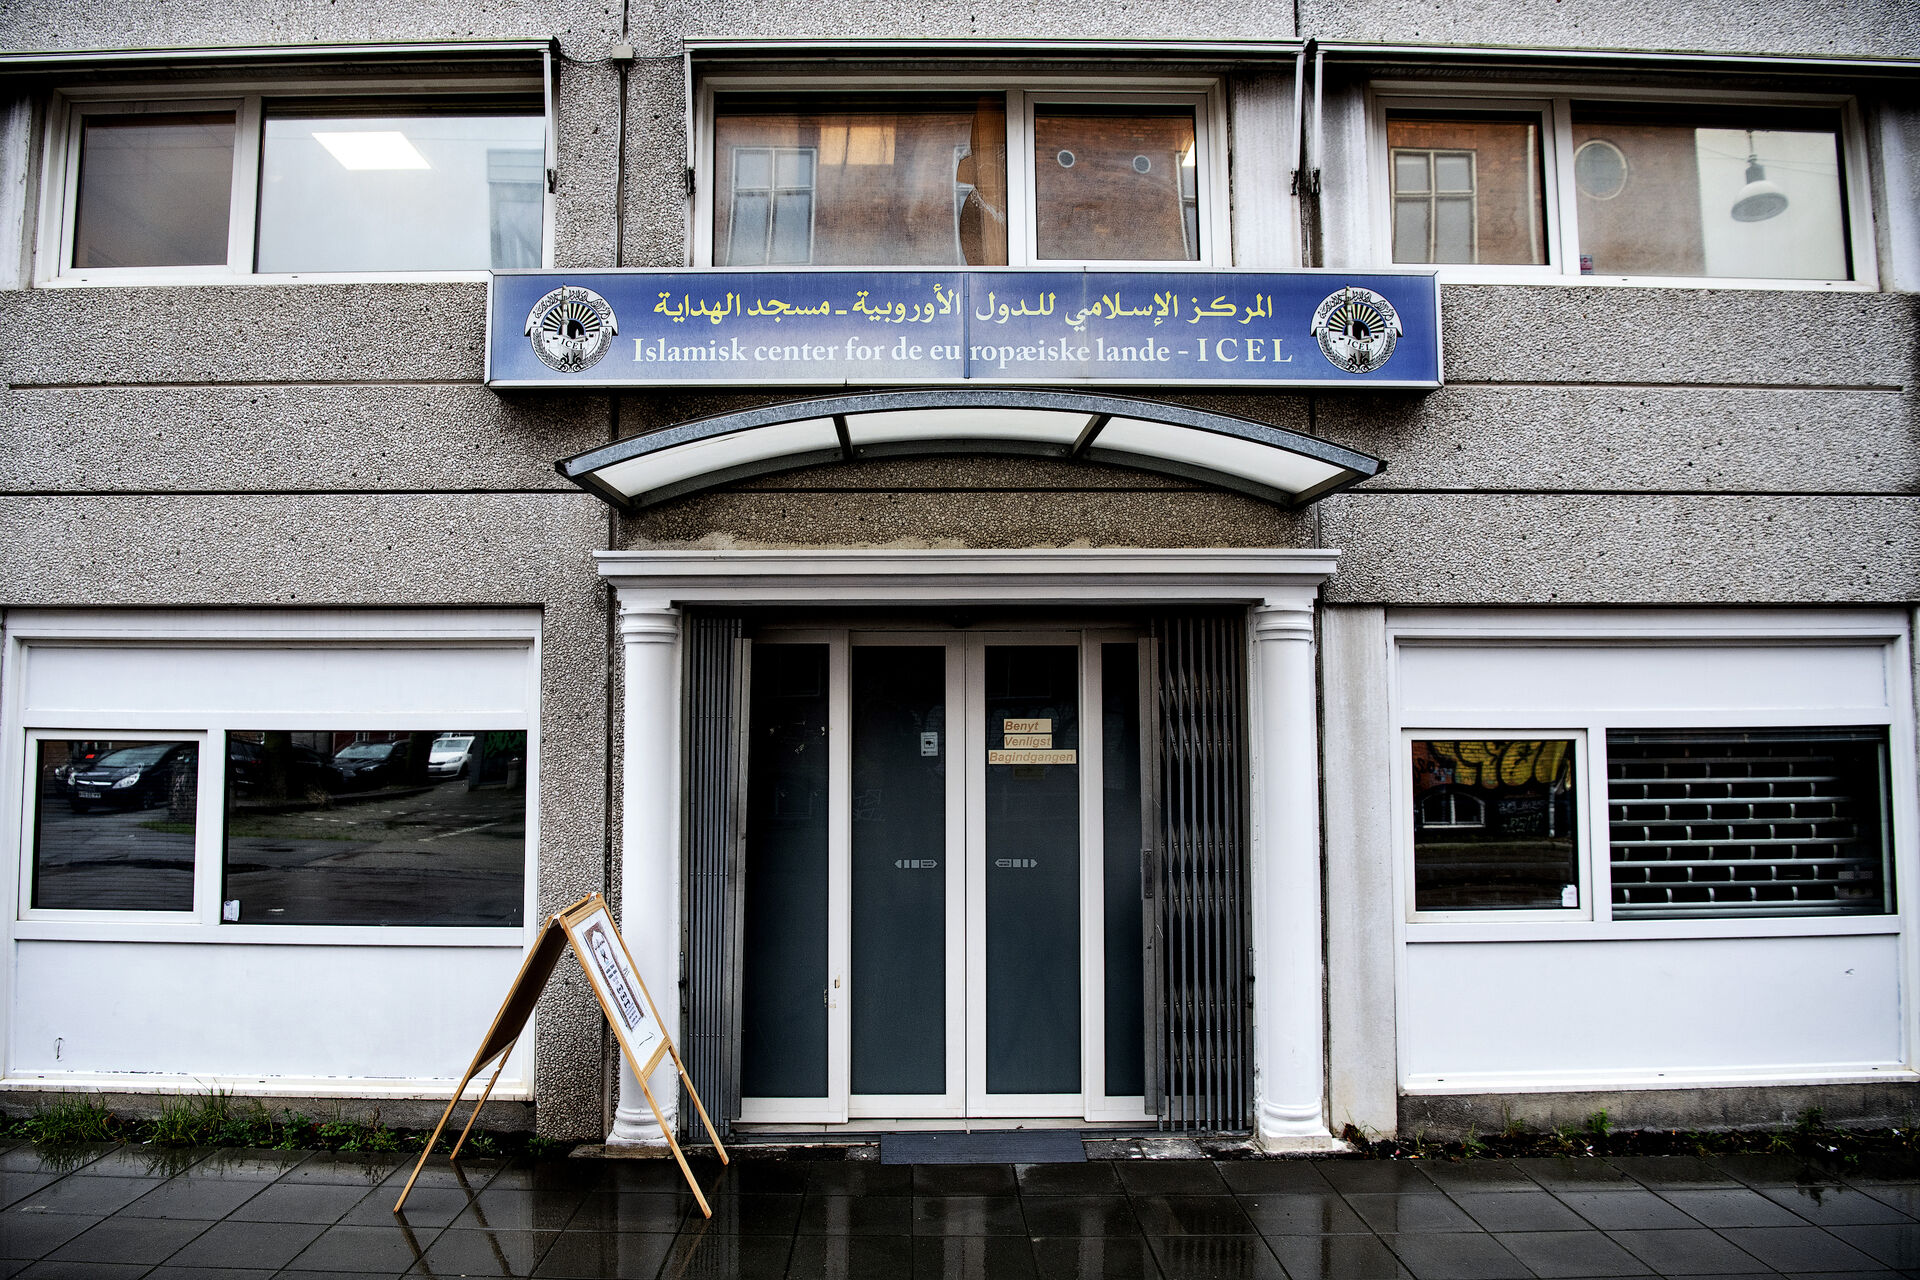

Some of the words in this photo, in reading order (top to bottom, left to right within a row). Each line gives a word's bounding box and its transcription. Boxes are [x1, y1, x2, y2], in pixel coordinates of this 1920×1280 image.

[652, 291, 742, 325] الهداية
[747, 297, 830, 323] مسجد
[852, 283, 962, 324] الأوروبية
[974, 290, 1057, 325] للدول
[1064, 290, 1179, 332] الإسلامي
[1186, 292, 1273, 325] المركز
[632, 336, 749, 363] Islamisk
[754, 341, 839, 362] center
[844, 335, 885, 362] for
[891, 335, 923, 361] de
[1095, 337, 1171, 362] lande
[1196, 338, 1294, 363] ICEL
[1004, 720, 1039, 733] Benyt
[1004, 736, 1051, 748] Venligst
[989, 751, 1074, 764] Bagindgangen
